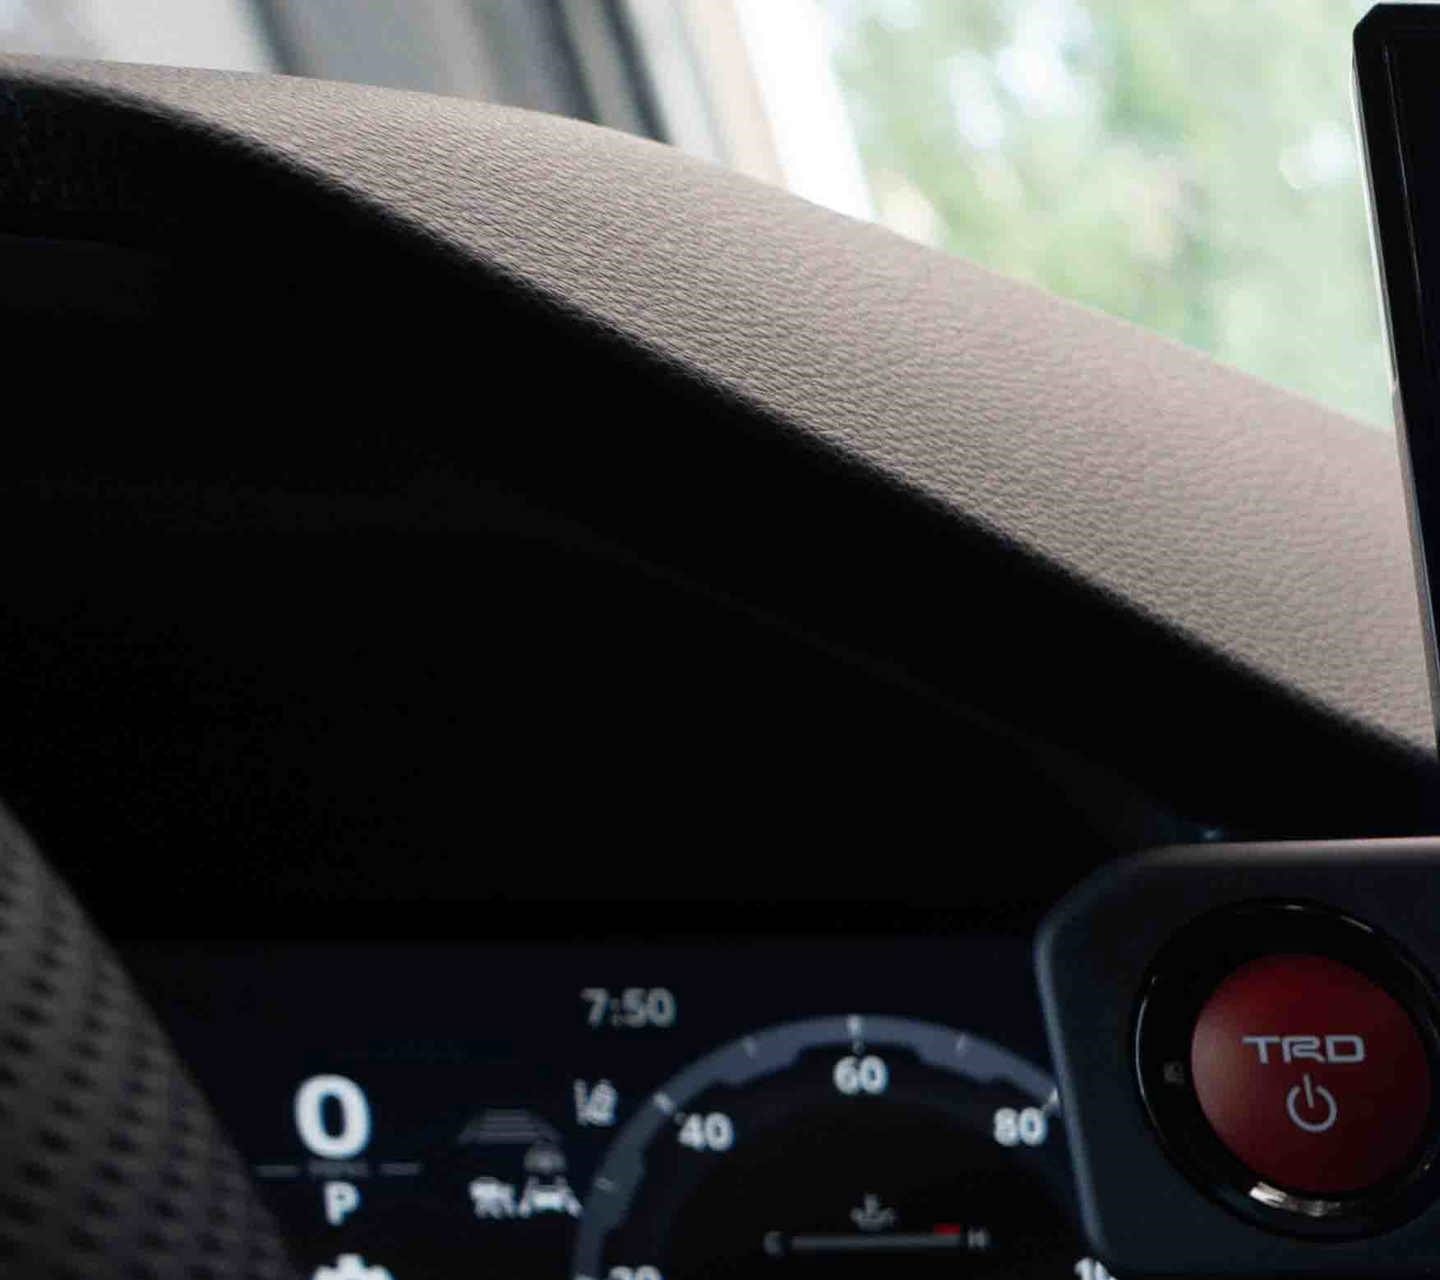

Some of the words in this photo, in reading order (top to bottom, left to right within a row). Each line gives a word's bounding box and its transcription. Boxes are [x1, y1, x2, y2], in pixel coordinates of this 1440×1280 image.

[580, 987, 677, 1028] 7:50
[1241, 1034, 1366, 1064] TRD
[832, 1054, 890, 1095] 60
[294, 1074, 371, 1160] 0
[678, 1112, 735, 1151] 40
[992, 1106, 1049, 1148] 80
[324, 1181, 360, 1225] P
